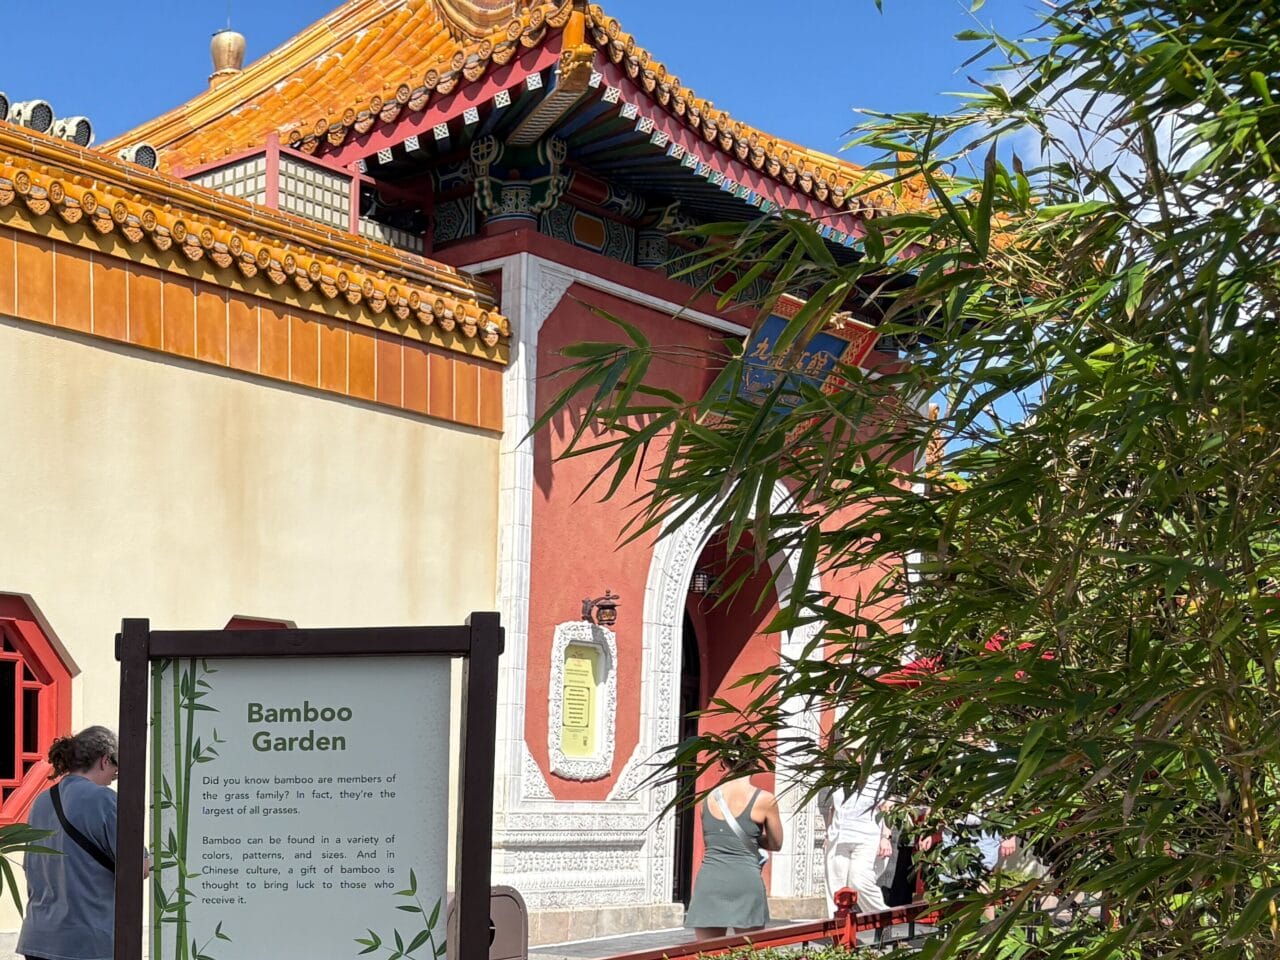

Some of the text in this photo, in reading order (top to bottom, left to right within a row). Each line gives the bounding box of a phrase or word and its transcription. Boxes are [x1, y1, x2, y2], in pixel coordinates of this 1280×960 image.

[248, 701, 352, 723] Bamboo
[253, 730, 346, 752] Garden
[203, 773, 396, 787] Did you know bamboo are members of
[203, 788, 396, 802] the grass family? In fact, they're the
[203, 804, 300, 817] largest of all grasses.
[203, 835, 241, 844] Bamboo
[247, 837, 263, 845] can
[269, 834, 281, 844] be
[288, 834, 315, 844] found
[321, 834, 329, 843] in
[347, 836, 379, 846] variety
[385, 833, 395, 843] of
[202, 849, 395, 862] colors, patterns, and sizes. And in
[202, 864, 239, 874] Chinese
[246, 865, 280, 875] culture,
[301, 865, 316, 876] gift
[324, 864, 334, 874] of
[341, 864, 380, 873] bamboo
[388, 863, 395, 873] is
[202, 879, 395, 891] thought to bring luck to those who
[202, 895, 246, 904] receive it.
